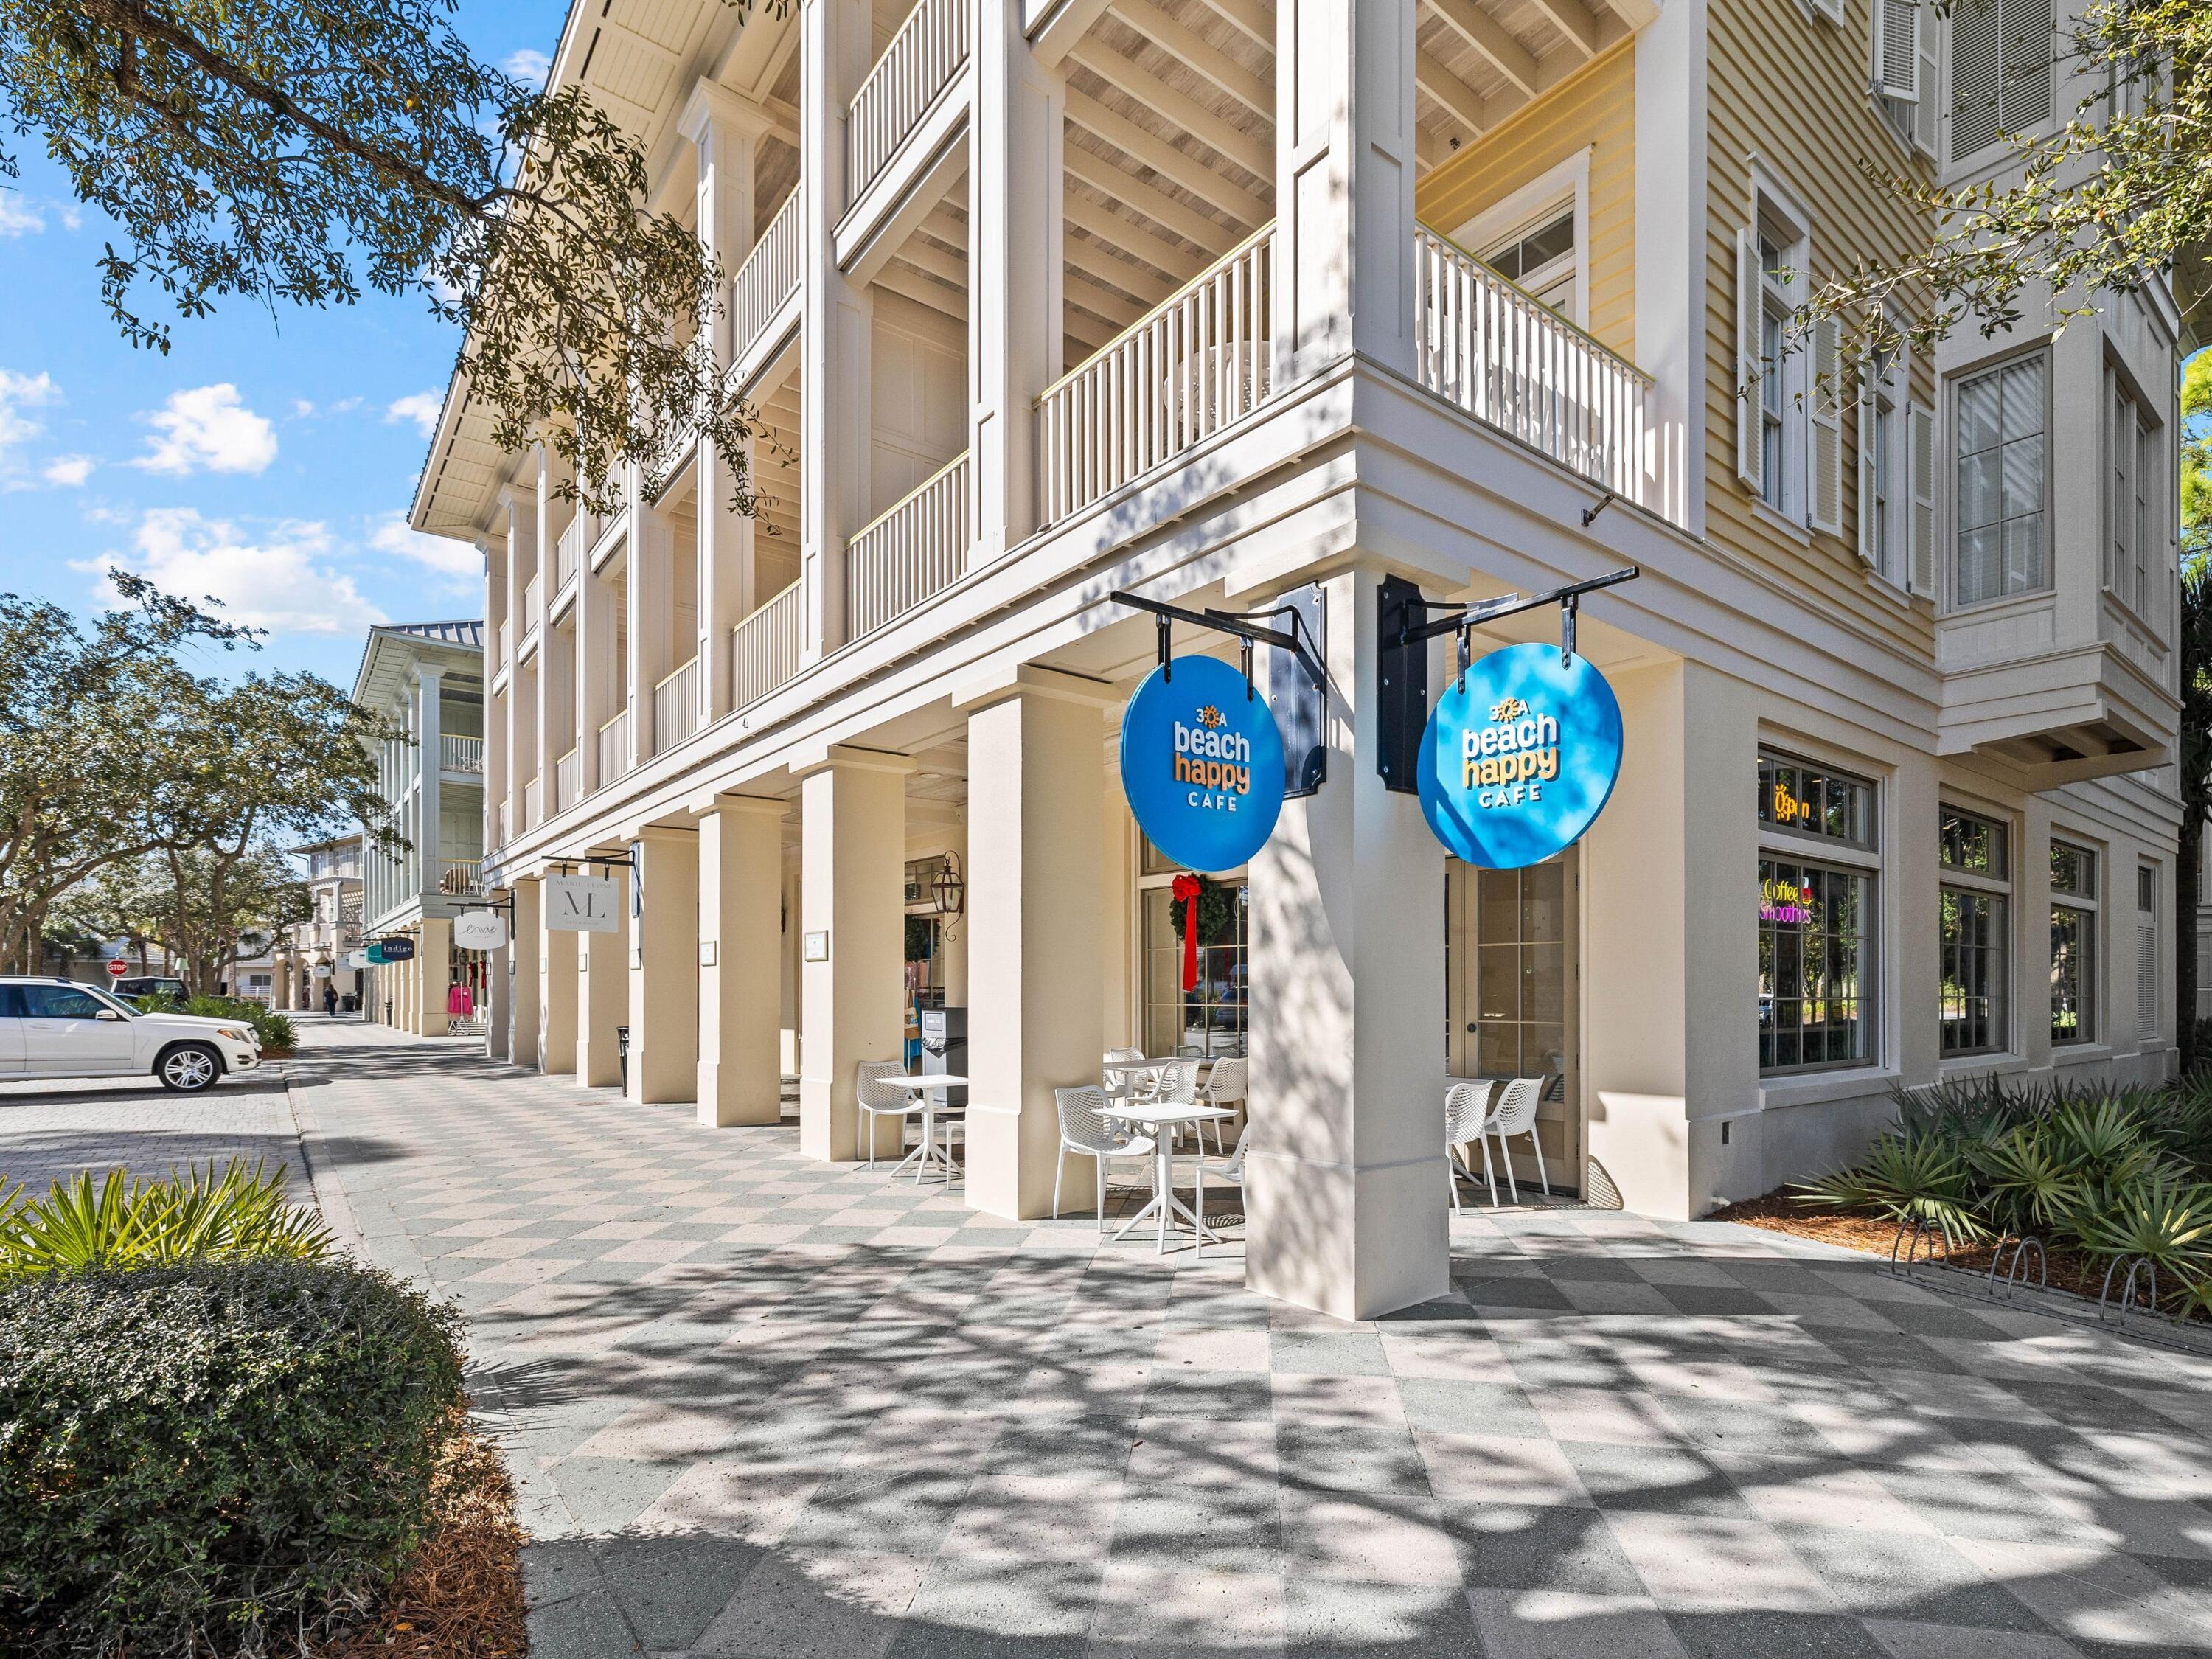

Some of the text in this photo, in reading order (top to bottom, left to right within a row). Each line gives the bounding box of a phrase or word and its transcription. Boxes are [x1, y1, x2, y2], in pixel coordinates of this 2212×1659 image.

[1175, 721, 1250, 762] beach
[1463, 713, 1557, 758] beach
[1175, 752, 1250, 795] happy
[1463, 746, 1557, 788] happy
[1188, 791, 1237, 811] CAFE
[1479, 784, 1540, 807] CAFE
[562, 891, 605, 918] ML
